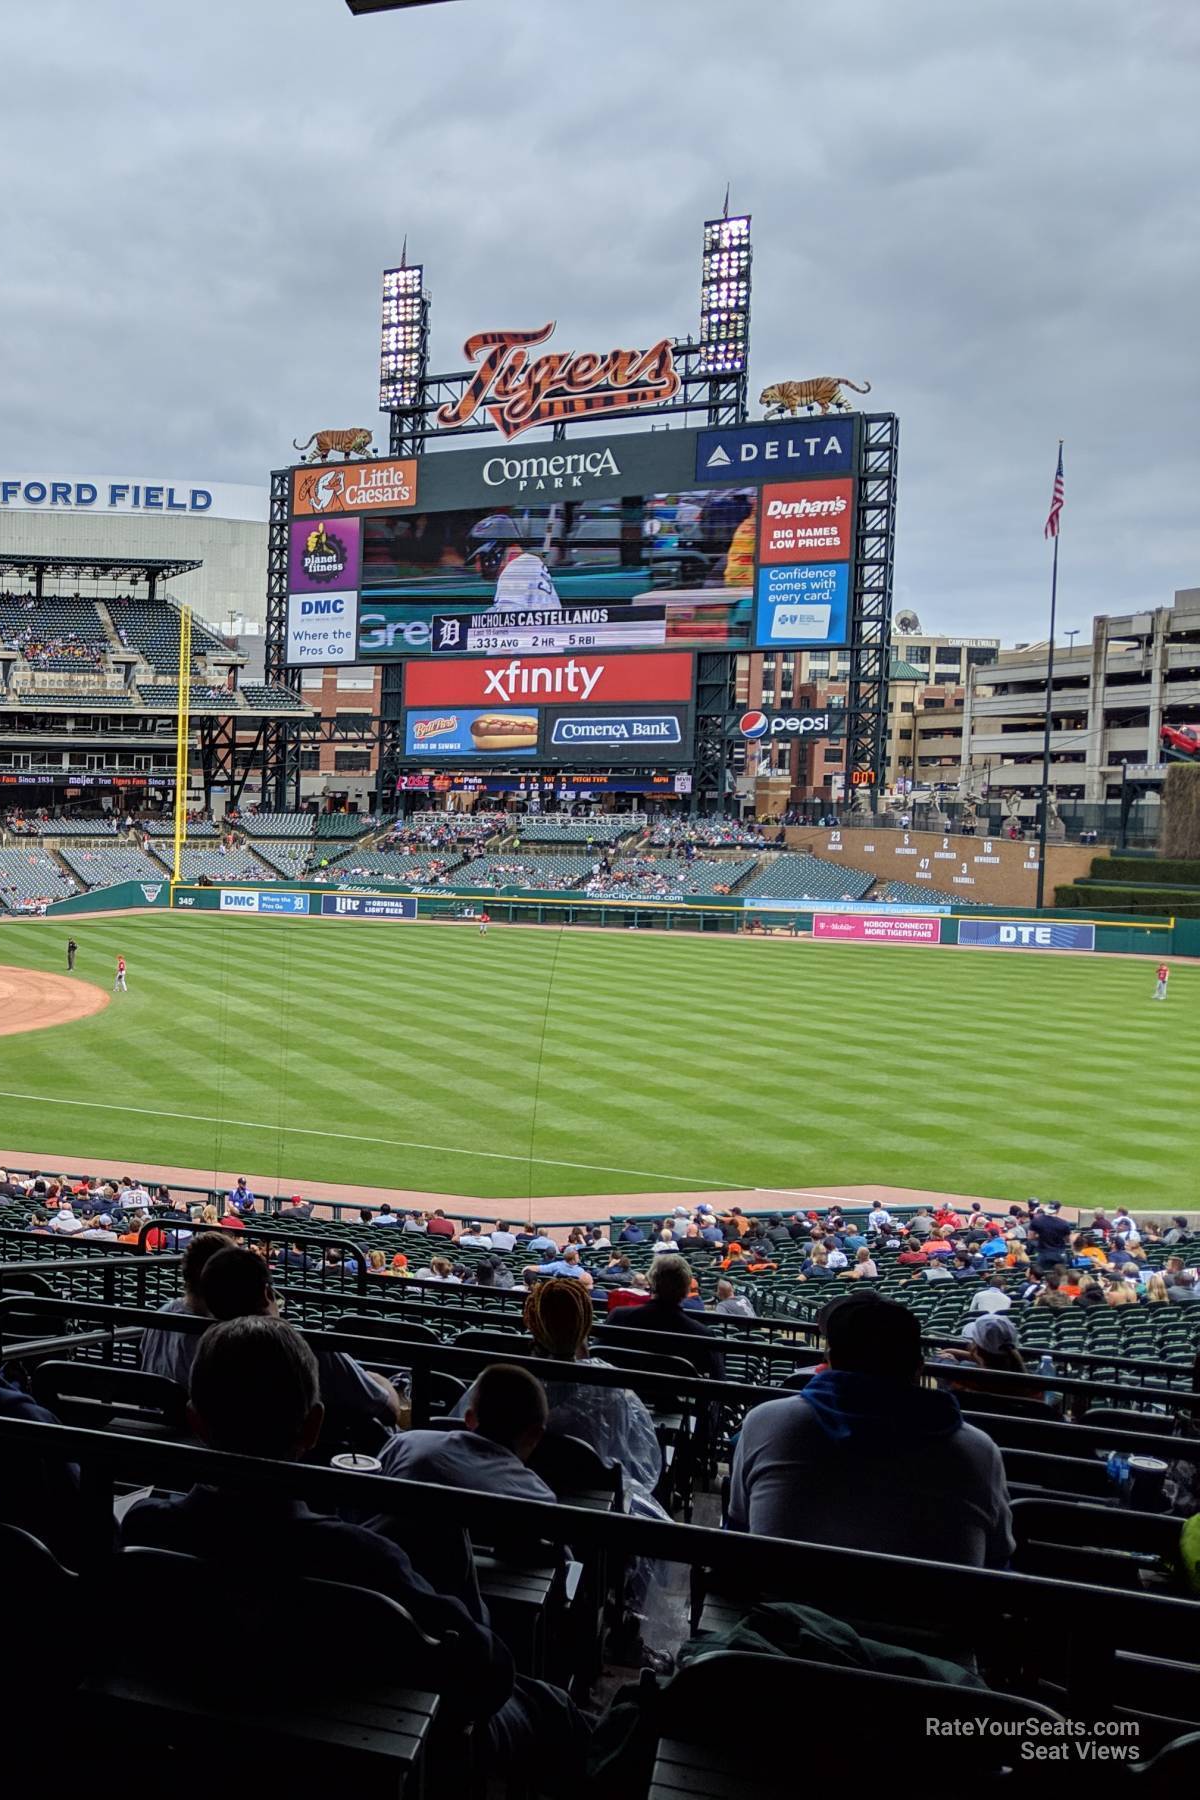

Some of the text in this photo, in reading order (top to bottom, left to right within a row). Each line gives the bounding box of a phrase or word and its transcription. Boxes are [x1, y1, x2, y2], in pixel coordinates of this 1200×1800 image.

[437, 320, 681, 445] Tigers
[740, 435, 842, 463] DELTA
[359, 466, 404, 488] Little
[519, 476, 582, 492] PARK
[0, 481, 212, 512] FORD FIELD
[345, 485, 412, 505] Caesars
[767, 495, 847, 518] Dunham's
[773, 527, 838, 539] BIG NAMES
[769, 537, 841, 550] LOW PRICES
[304, 554, 337, 570] planet
[308, 562, 343, 573] fitness
[769, 568, 836, 581] Confidence
[769, 579, 836, 591] comes with
[768, 589, 833, 604] every card.
[301, 599, 344, 616] DMC
[471, 609, 609, 628] NICHOLAS CASTELLANOS
[293, 629, 352, 642] Where the
[532, 636, 555, 647] 2 HR
[569, 635, 596, 646] 5 RBI
[472, 637, 519, 649] .333 AVG
[299, 644, 344, 656] Pros Go
[484, 659, 605, 702] xfinity
[633, 723, 670, 736] Bank
[771, 714, 829, 735] pepsi
[2, 776, 17, 784] Fans
[18, 775, 35, 784] Since
[37, 776, 54, 785] 1934
[69, 776, 165, 787] meijer True Tigers Fans Since
[831, 831, 841, 842] 23
[904, 834, 909, 845] 5
[942, 838, 948, 849] 2
[983, 842, 992, 853] 16
[1029, 847, 1035, 858] 6
[919, 858, 929, 869] 47
[961, 864, 967, 875] 3
[224, 895, 255, 907] DMC
[262, 895, 281, 903] Where
[586, 891, 683, 902] MotorCityCasino.com
[335, 897, 404, 914] Lite ORIGINAL
[863, 920, 934, 931] NOBODY CONNECTS
[864, 928, 932, 939] MORE TIGERS FANS
[999, 925, 1052, 944] DTE
